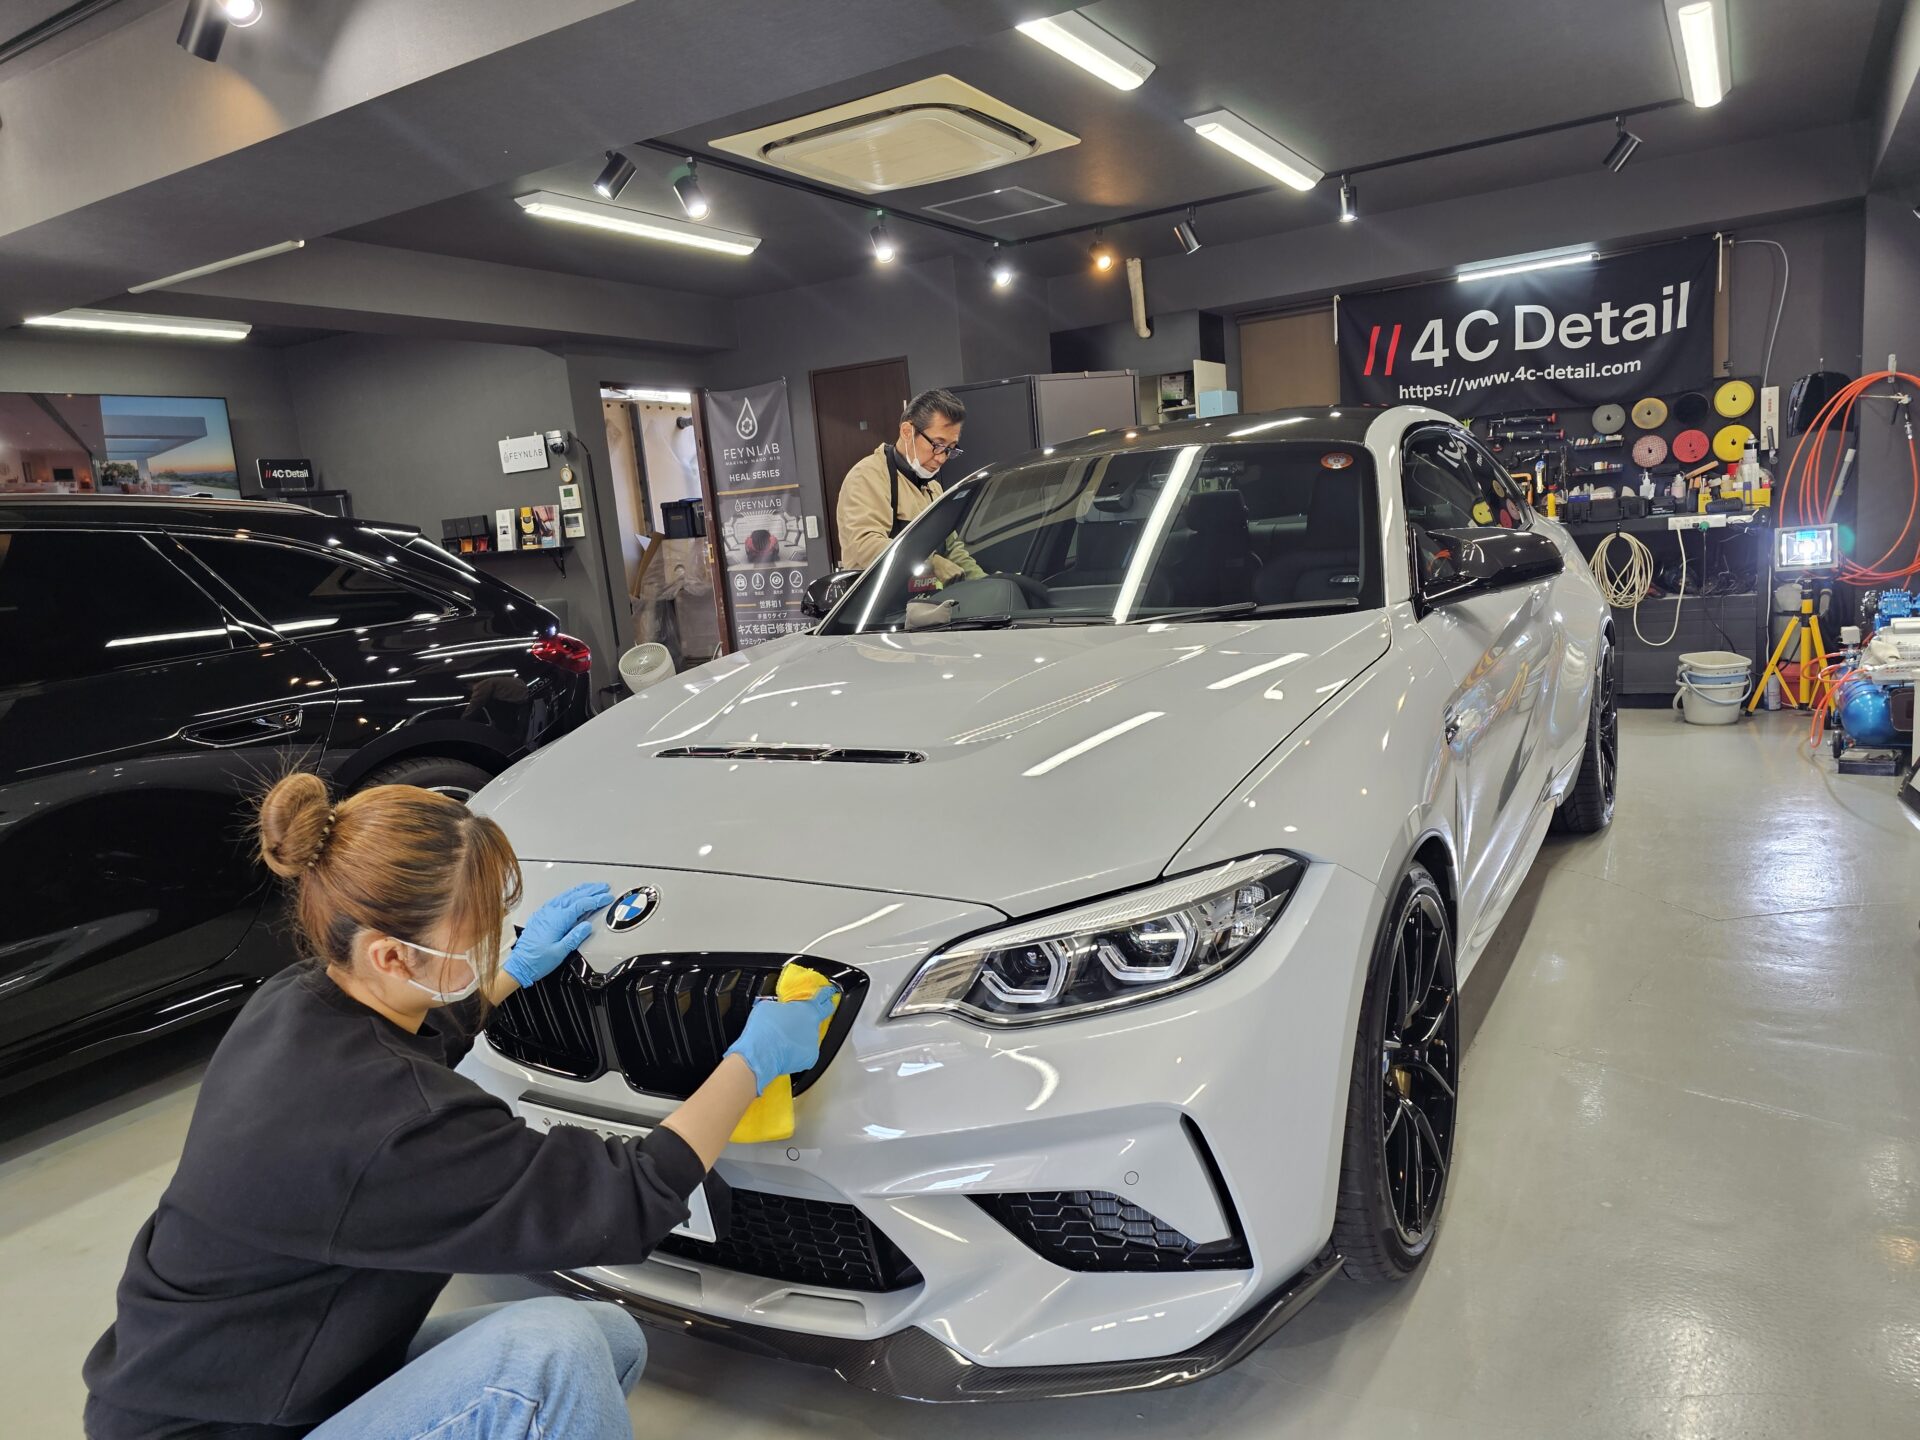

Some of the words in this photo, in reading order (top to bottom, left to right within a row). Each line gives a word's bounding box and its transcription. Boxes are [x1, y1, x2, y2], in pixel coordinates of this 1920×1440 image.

[1513, 280, 1691, 352] Detail
[1398, 357, 1642, 401] https://www.4c-detail.com
[508, 448, 544, 461] FEYNLAB
[723, 443, 780, 460] FEYNLAB
[285, 468, 309, 478] Detail
[729, 473, 751, 482] HEAL
[752, 469, 780, 479] SERIES
[741, 498, 782, 510] FEYNLAB
[914, 577, 937, 587] RUPE
